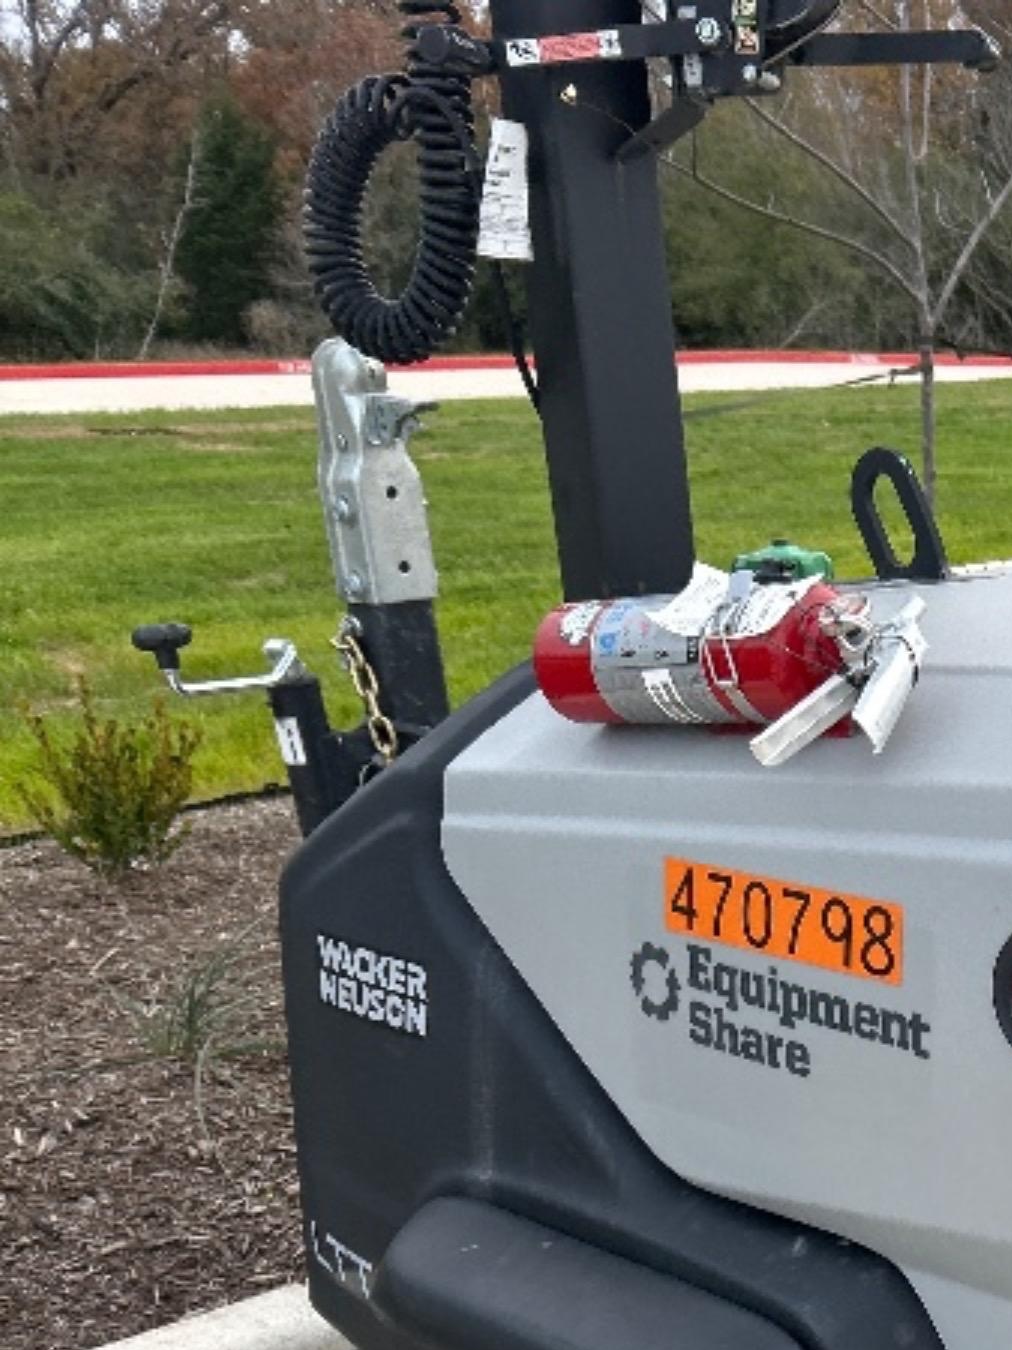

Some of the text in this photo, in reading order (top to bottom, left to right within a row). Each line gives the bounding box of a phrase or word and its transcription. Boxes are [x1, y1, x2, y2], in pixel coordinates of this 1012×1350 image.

[671, 866, 895, 977] 470798
[316, 933, 428, 1002] WACKER
[320, 968, 427, 1038] NEUSON
[686, 943, 931, 1060] Equipment
[689, 1001, 811, 1077] Share
